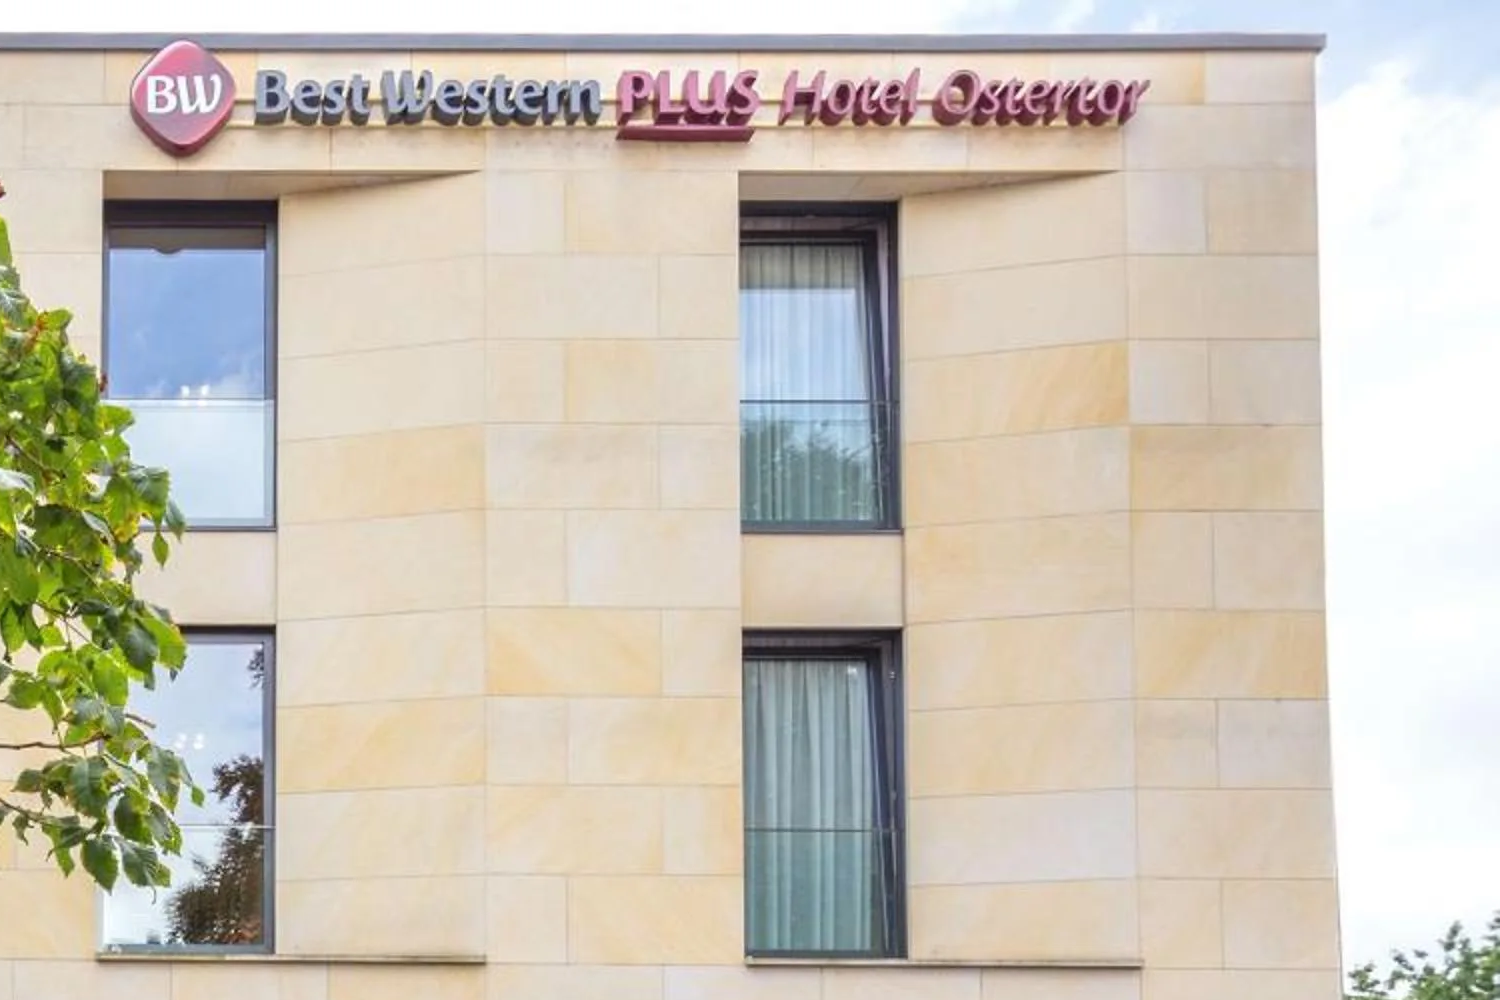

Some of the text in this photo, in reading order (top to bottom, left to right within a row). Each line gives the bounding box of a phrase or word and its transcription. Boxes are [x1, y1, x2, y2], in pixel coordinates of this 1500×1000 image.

[146, 74, 223, 115] BW
[255, 67, 1150, 128] Best Western PLUS Hotel Ostertor
